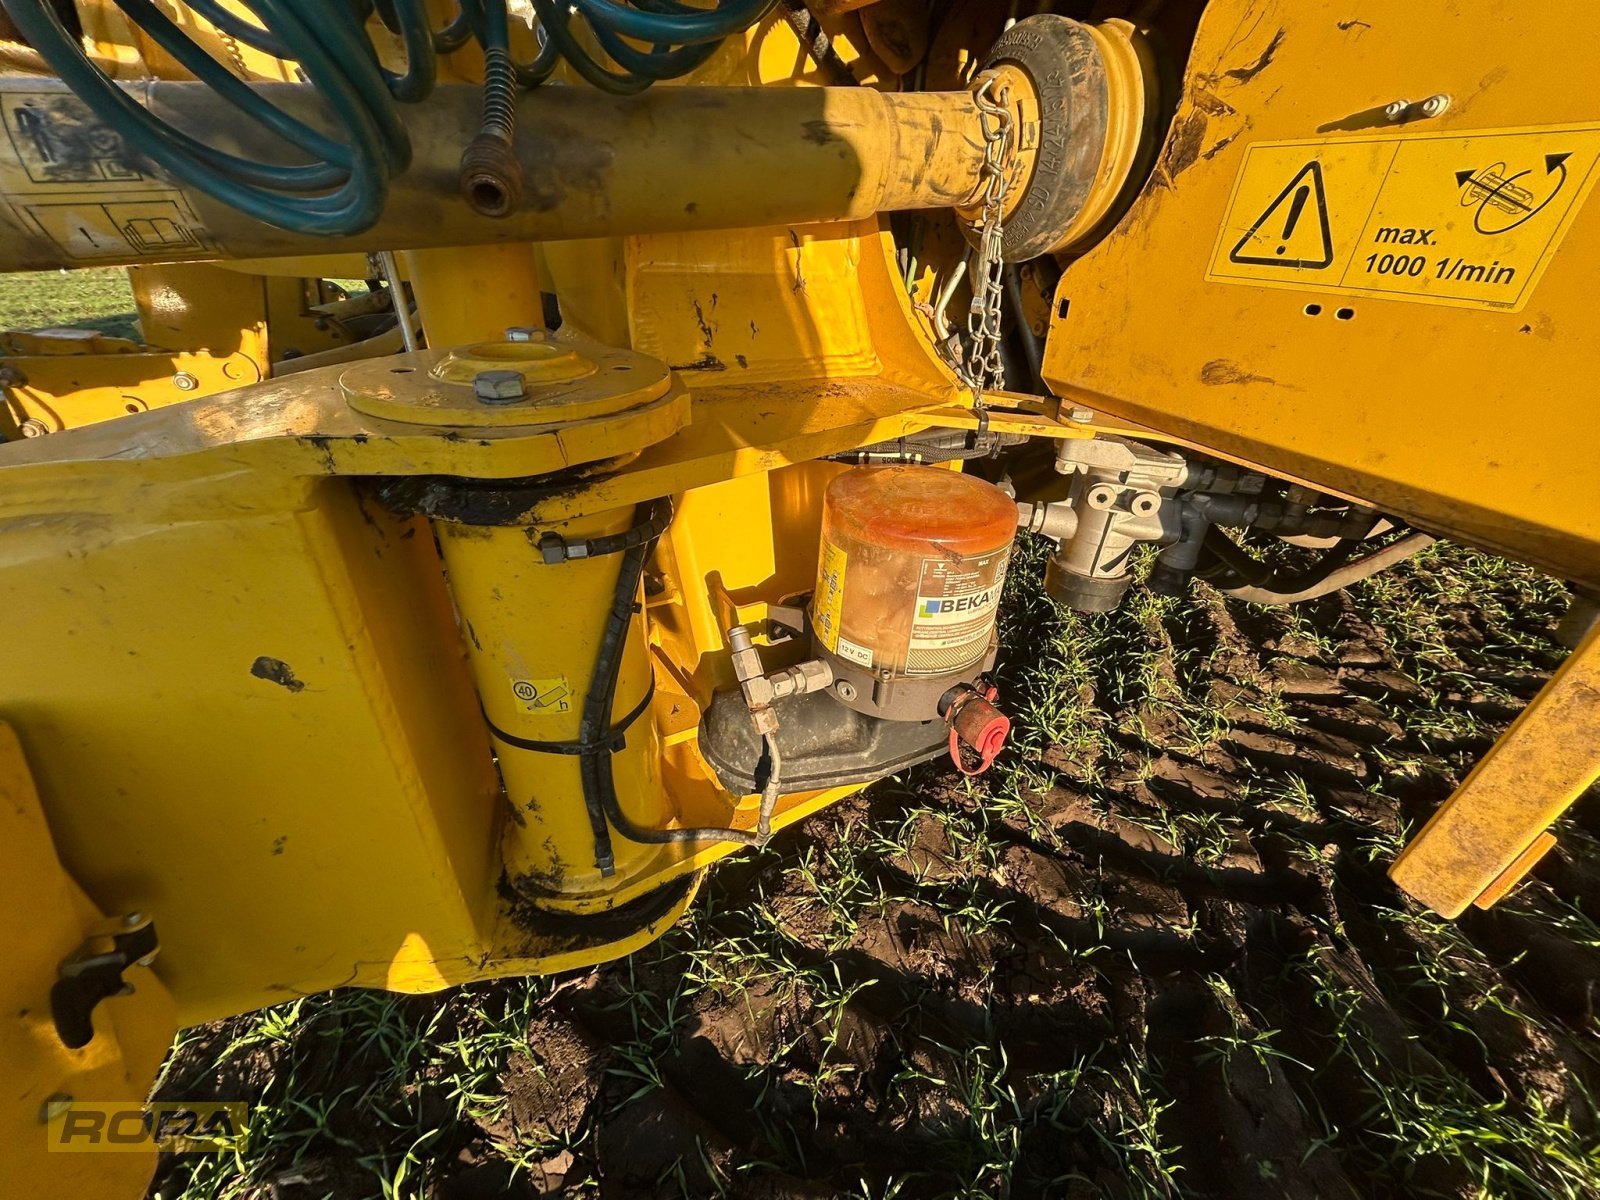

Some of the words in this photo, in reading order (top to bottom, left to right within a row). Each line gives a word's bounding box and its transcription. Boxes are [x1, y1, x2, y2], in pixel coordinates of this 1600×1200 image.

[1374, 226, 1437, 246] max.
[1365, 253, 1426, 277] 1000
[1435, 258, 1515, 285] 1/min
[857, 651, 869, 660] DC
[518, 686, 532, 697] 40
[559, 700, 568, 710] h
